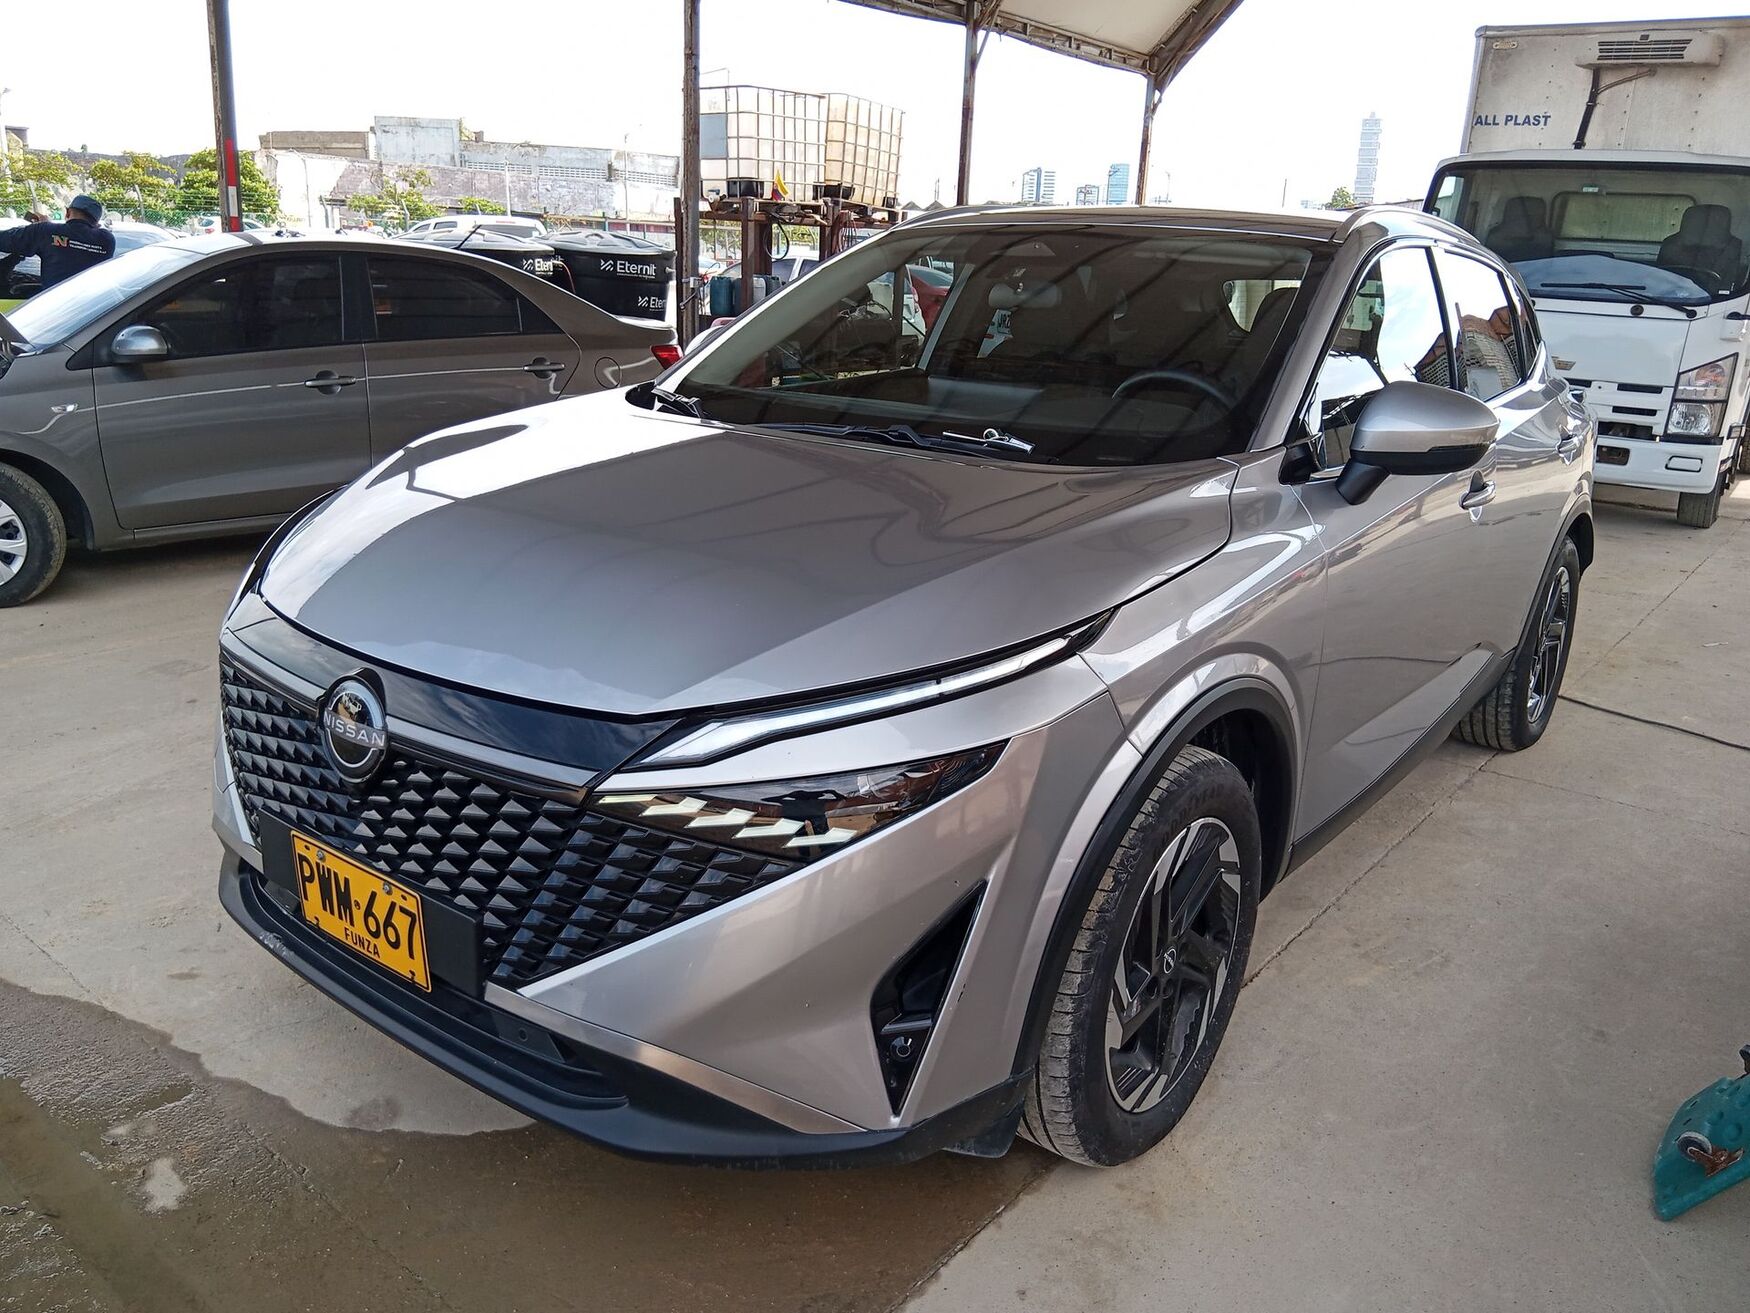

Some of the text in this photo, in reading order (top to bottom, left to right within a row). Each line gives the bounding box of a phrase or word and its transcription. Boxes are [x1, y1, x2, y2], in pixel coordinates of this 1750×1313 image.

[1474, 114, 1551, 127] ALL PLAST
[51, 234, 69, 248] N
[616, 260, 657, 276] Eternit
[323, 710, 386, 748] NISSAN
[344, 926, 381, 959] FUNZA
